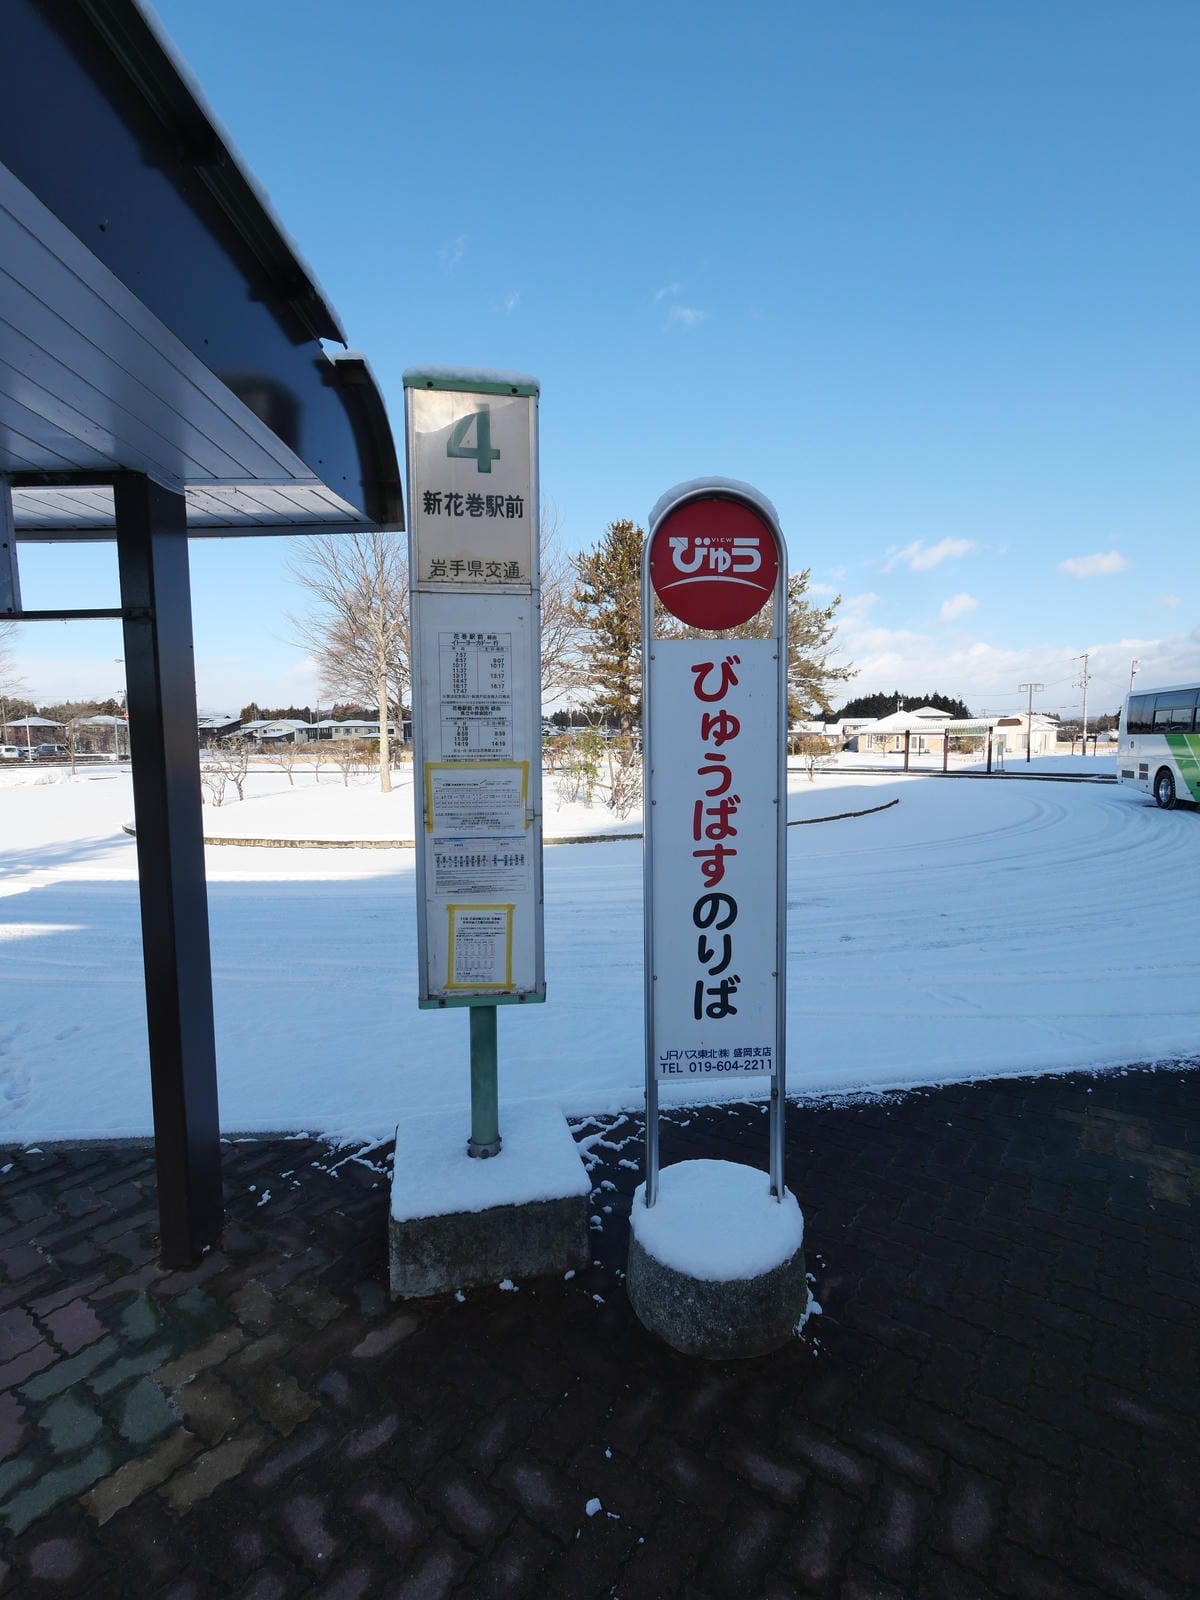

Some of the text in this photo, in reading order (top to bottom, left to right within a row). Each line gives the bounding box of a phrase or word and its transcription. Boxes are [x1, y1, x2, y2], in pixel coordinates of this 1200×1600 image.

[447, 403, 501, 474] 4
[422, 490, 524, 519] 新花巻駅前
[430, 559, 521, 580] 岩手県交通
[668, 536, 762, 574] びゅう
[690, 654, 742, 1021] びゅうばすのりば
[660, 1059, 772, 1074] TEL 019-604-2211
[733, 1047, 772, 1058] 盛岡支店
